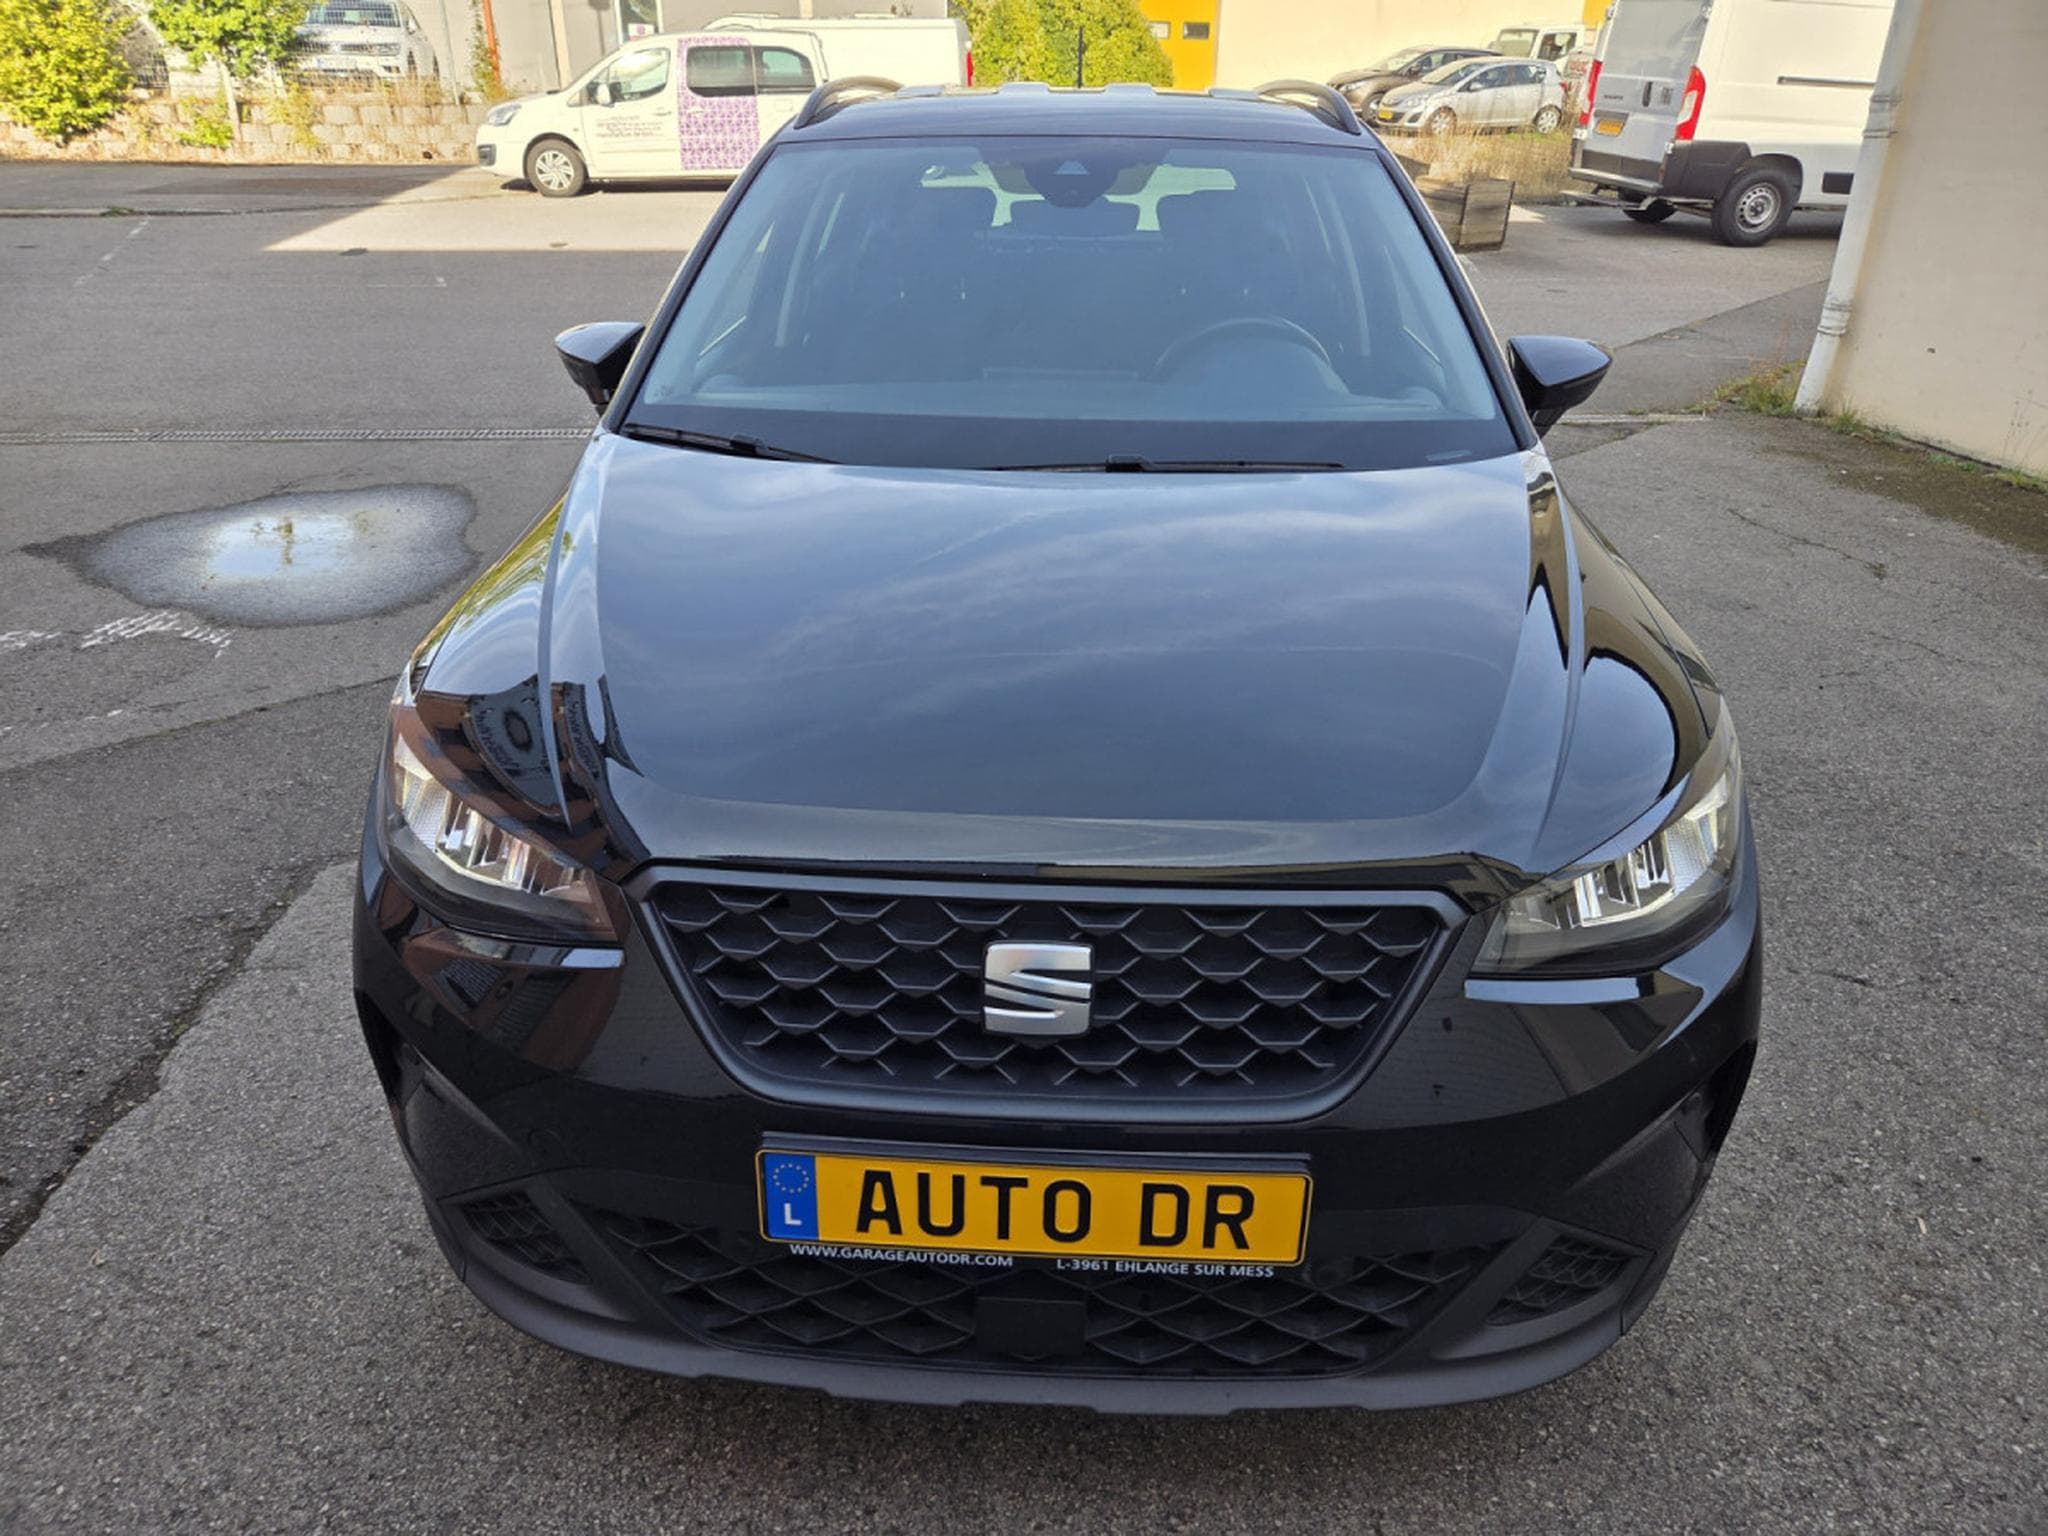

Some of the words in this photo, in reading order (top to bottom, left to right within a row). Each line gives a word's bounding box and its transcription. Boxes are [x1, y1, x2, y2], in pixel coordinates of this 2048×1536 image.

[784, 1203, 802, 1225] L
[856, 1169, 1092, 1243] AUTO
[1140, 1183, 1255, 1249] DR
[789, 1244, 1013, 1267] WWW.GARAGEAUTODR.COM
[1056, 1258, 1109, 1271] L-3961
[1115, 1260, 1189, 1275] EHLANGE
[1194, 1264, 1225, 1276] SUR
[1229, 1266, 1275, 1278] MESS
